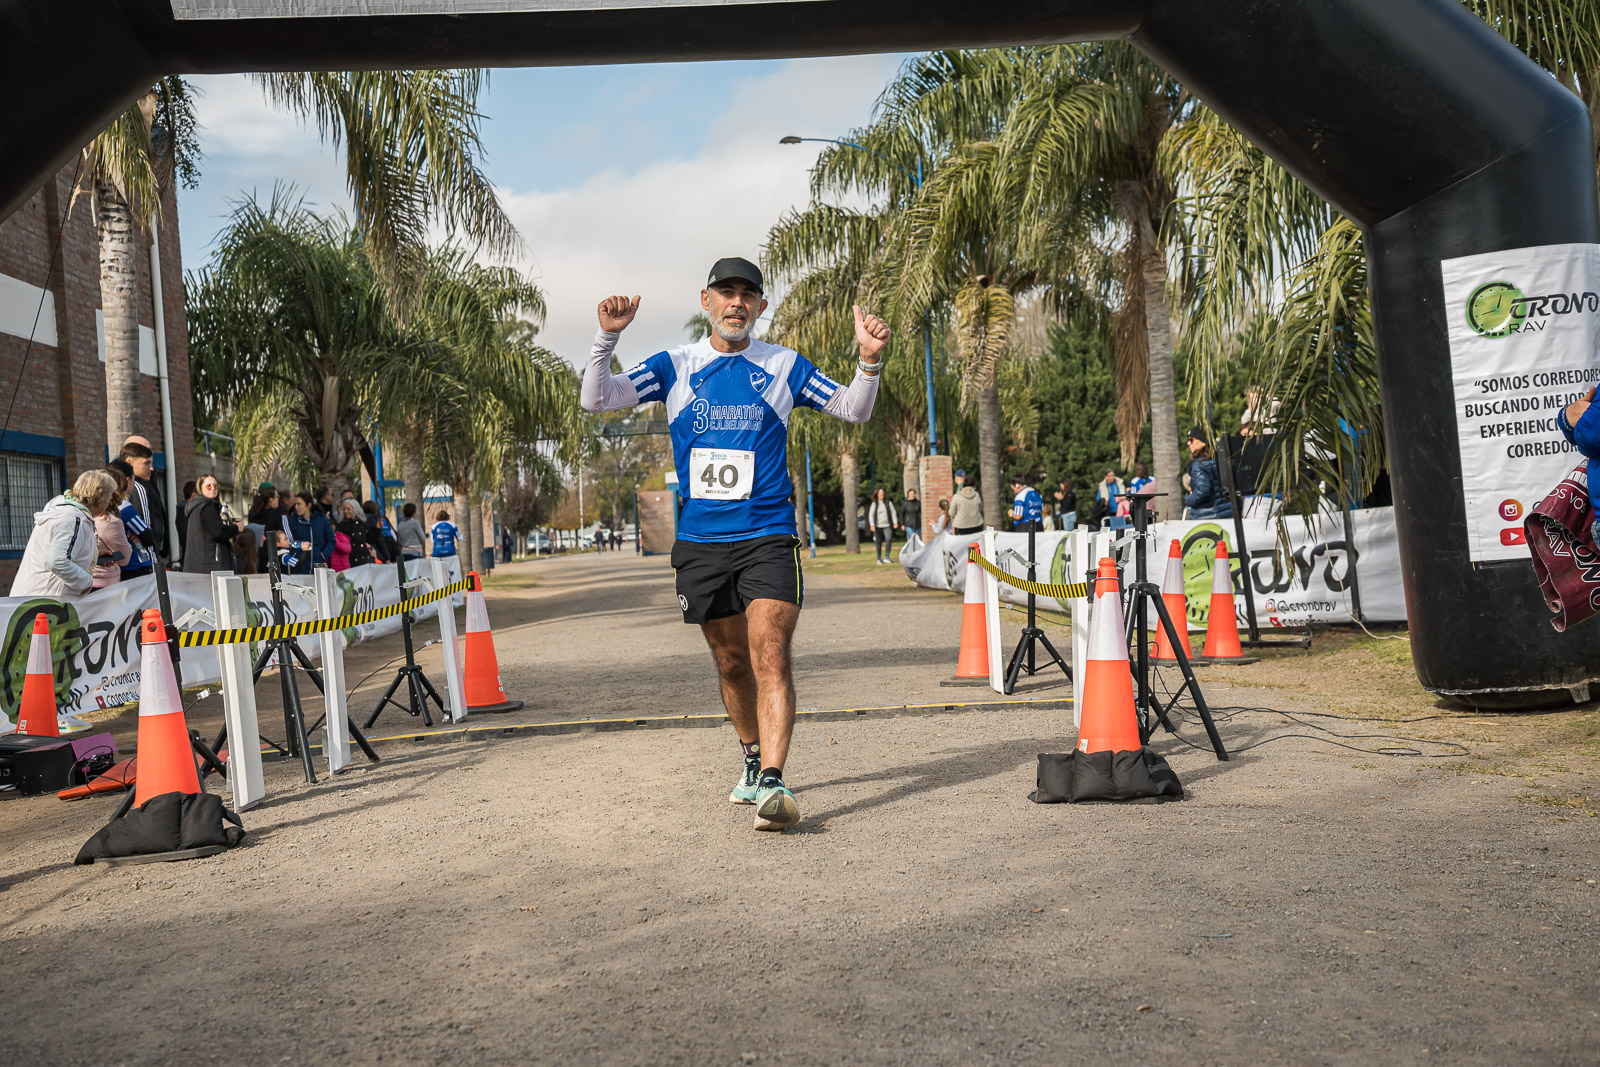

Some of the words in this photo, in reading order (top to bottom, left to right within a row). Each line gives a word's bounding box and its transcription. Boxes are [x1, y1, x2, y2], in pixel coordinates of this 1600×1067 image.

[1510, 291, 1599, 319] CRONO
[1509, 320, 1547, 335] RAV
[1533, 368, 1600, 388] CORREDORE
[692, 398, 710, 434] 3
[710, 403, 764, 421] MARATÓN
[1465, 396, 1540, 418] BUSCANDO
[1480, 417, 1563, 439] EXPERIENCI
[700, 463, 739, 489] 40
